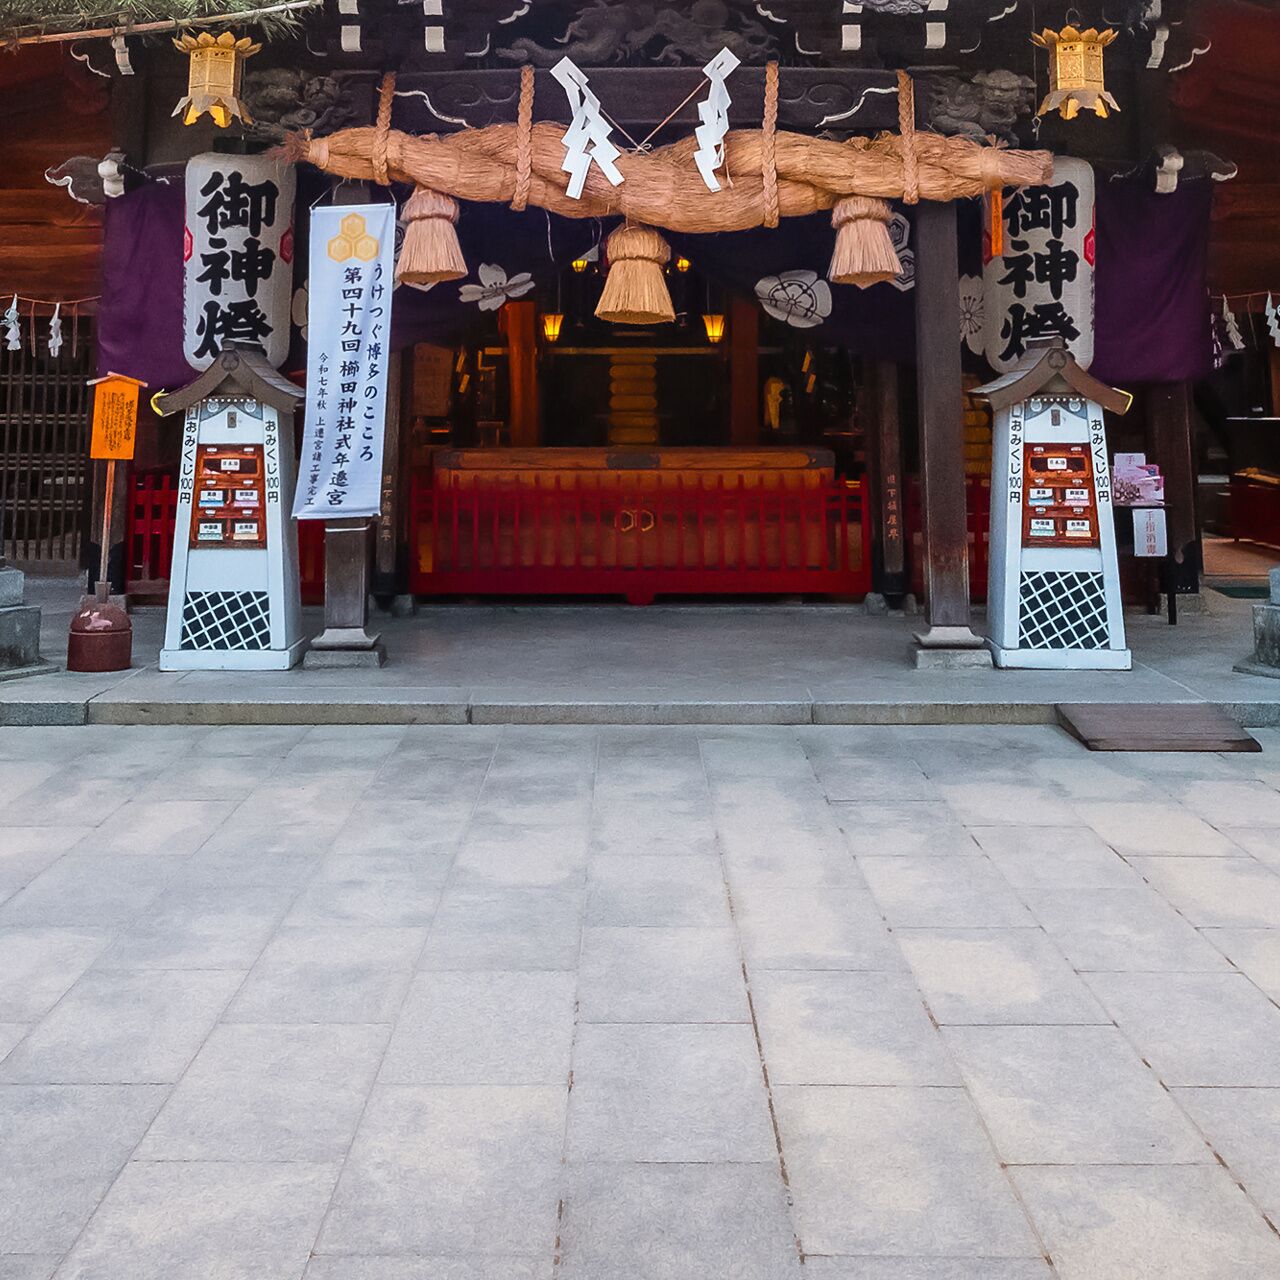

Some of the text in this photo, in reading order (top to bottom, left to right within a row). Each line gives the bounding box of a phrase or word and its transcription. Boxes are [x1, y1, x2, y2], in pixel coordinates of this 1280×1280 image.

[193, 170, 279, 360] 御神燈
[996, 180, 1081, 363] 御神燈
[340, 266, 364, 353] 第四十九回
[316, 351, 329, 411] 令和七年秋
[359, 263, 385, 462] うけつぐ博多のこころ
[179, 420, 197, 505] おみくじ100円
[265, 419, 280, 504] おみくじ100円
[1009, 419, 1022, 504] おみくじ100円
[1090, 419, 1110, 503] おみくじ100円
